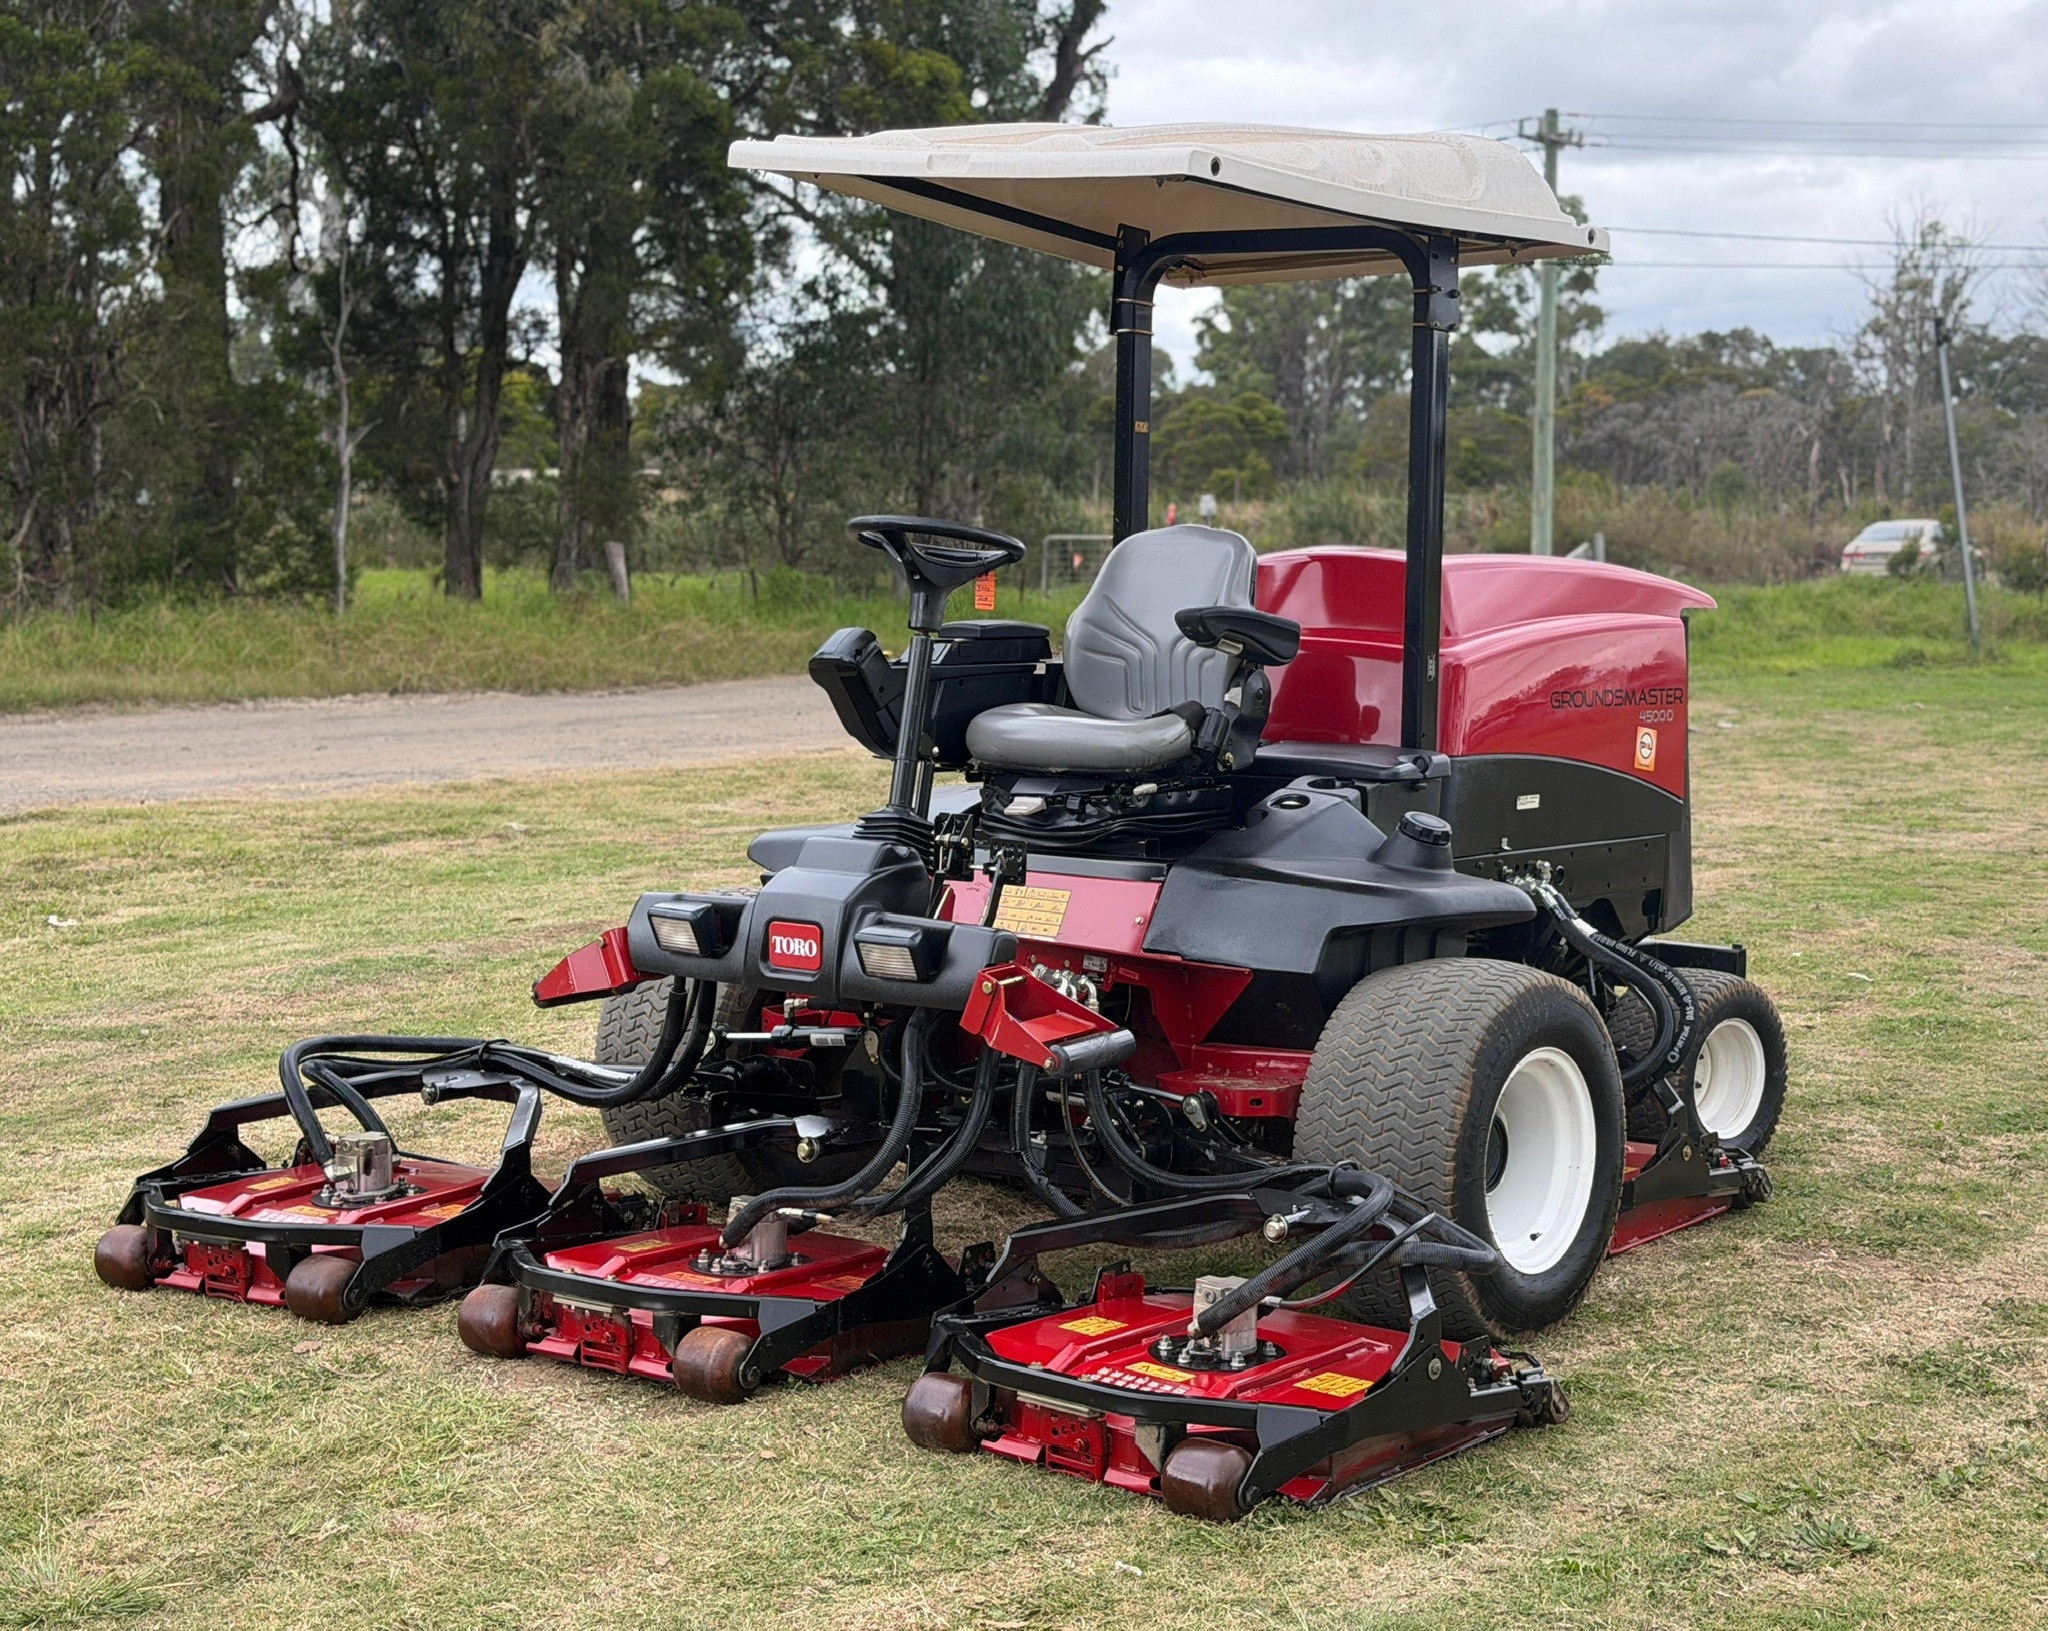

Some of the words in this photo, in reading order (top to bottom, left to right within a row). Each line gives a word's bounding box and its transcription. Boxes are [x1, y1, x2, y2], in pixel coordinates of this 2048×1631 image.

[1550, 687, 1684, 710] GROUNDSMASTER
[772, 935, 818, 958] TORO
[1615, 941, 1637, 958] FLUID
